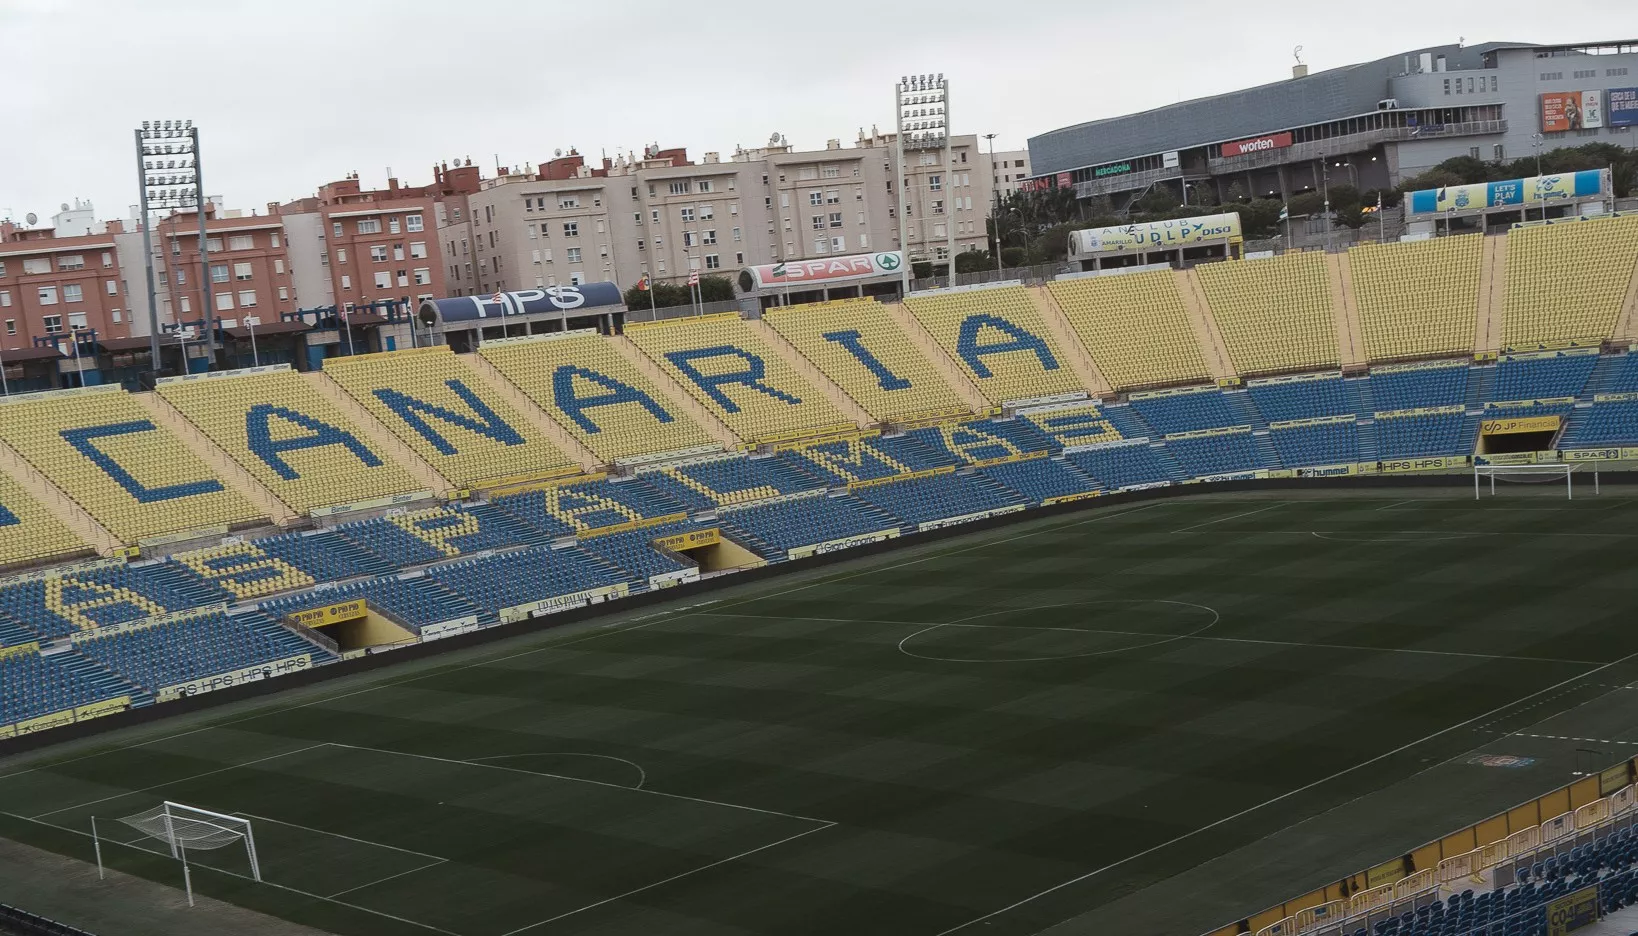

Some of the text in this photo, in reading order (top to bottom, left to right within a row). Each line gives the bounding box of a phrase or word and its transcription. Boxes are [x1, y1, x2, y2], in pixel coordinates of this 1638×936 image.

[1239, 139, 1274, 153] worten
[1095, 163, 1131, 177] MERCADONA
[1494, 184, 1516, 192] LET'S
[1495, 191, 1516, 200] PLAY
[785, 256, 873, 278] SPAR
[469, 286, 585, 318] HPS
[1504, 420, 1559, 431] JP Financial
[1313, 466, 1350, 476] hummel
[1383, 459, 1443, 470] HPS HPS
[74, 603, 223, 639] HPS HPS HPS HPS HPS HPS
[201, 675, 233, 691] HPS
[241, 666, 271, 682] HPS
[276, 657, 307, 672] HPS
